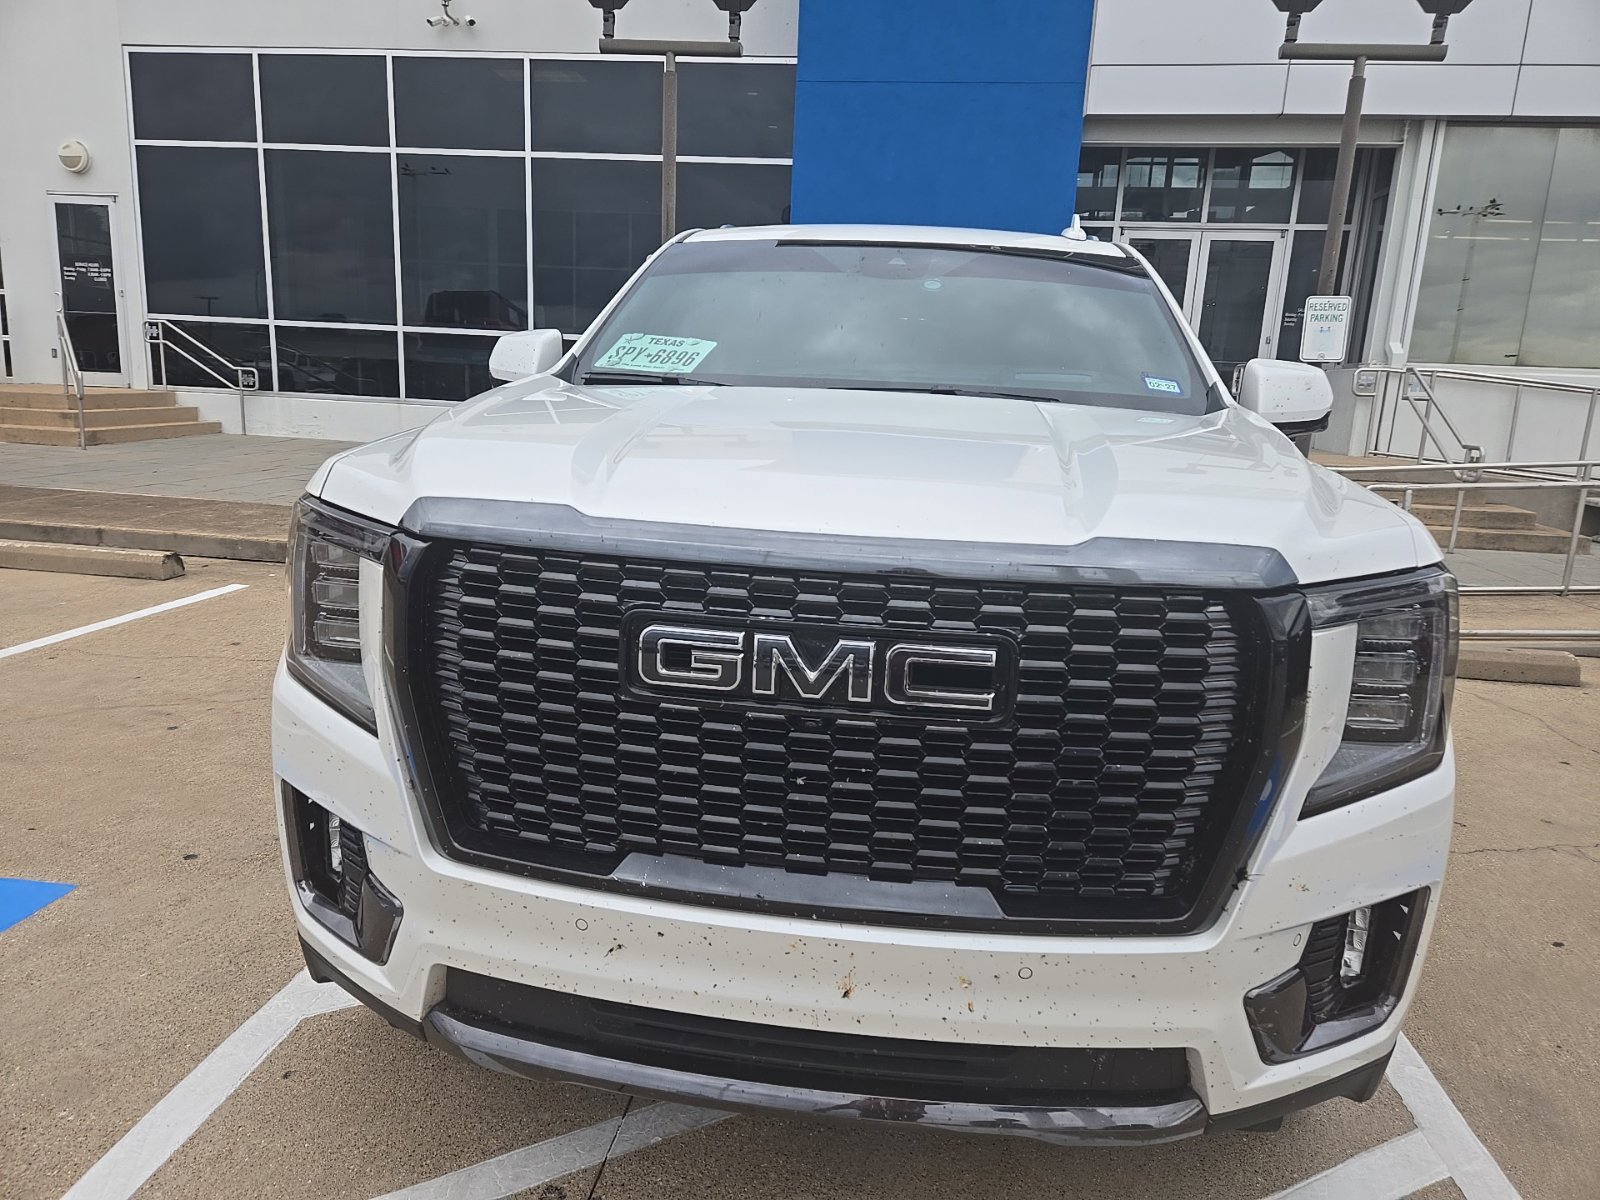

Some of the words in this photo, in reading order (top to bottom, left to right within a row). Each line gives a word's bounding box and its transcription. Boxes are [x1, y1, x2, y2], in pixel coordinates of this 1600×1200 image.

[1309, 303, 1347, 311] RESERVED
[1310, 313, 1343, 322] PARKING
[648, 337, 685, 347] TEXAS
[638, 623, 997, 711] GMC
